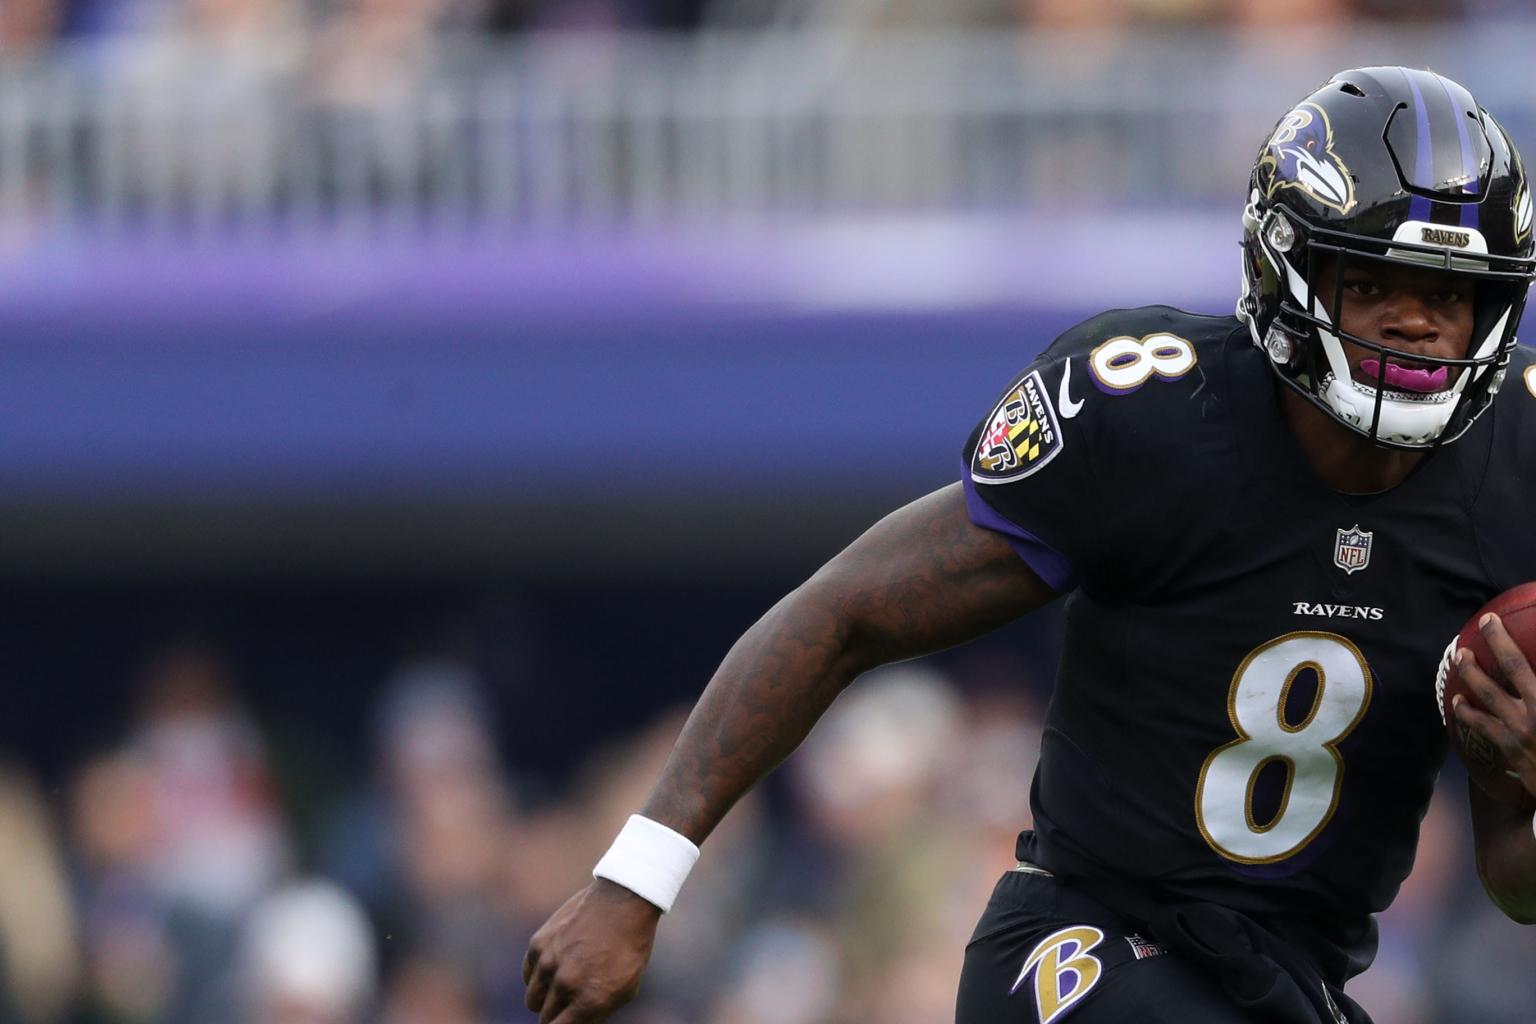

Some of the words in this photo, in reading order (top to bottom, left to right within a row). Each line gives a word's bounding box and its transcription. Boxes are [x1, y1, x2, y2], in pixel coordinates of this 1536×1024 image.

[1421, 227, 1470, 248] RAVENS
[1089, 332, 1198, 396] 8
[1024, 378, 1054, 444] RAVENS
[1340, 546, 1365, 566] NFL
[1292, 601, 1384, 620] RAVENS
[1194, 630, 1373, 865] 8
